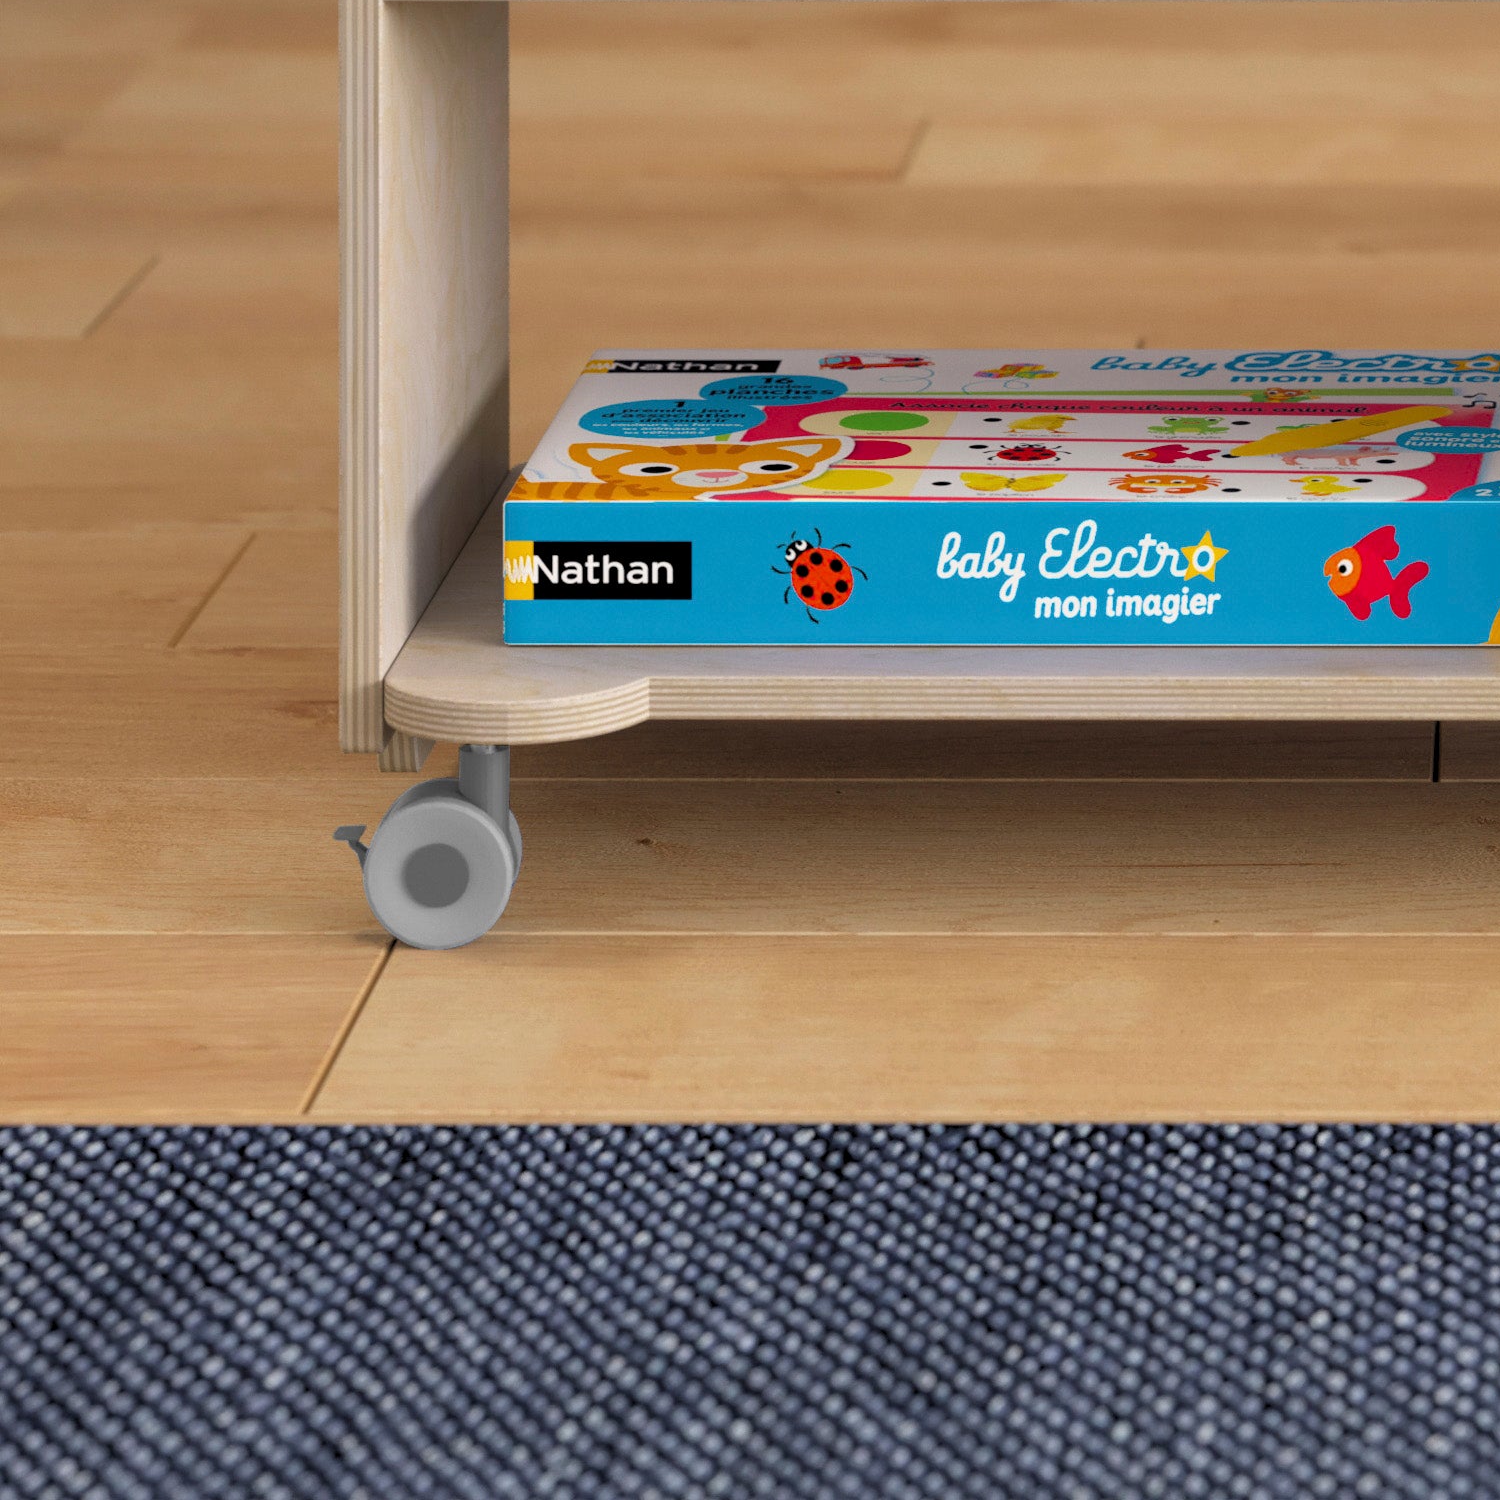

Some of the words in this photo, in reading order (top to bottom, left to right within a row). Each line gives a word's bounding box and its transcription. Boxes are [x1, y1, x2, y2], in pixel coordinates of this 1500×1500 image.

[611, 361, 759, 371] Nathan
[1090, 355, 1219, 377] baby
[1228, 351, 1500, 374] Electro
[1230, 374, 1322, 383] mon
[1000, 402, 1091, 411] chaque
[1100, 403, 1201, 412] couleur
[1475, 488, 1494, 497] 2
[533, 554, 674, 584] Nathan
[936, 531, 1026, 603] baby
[1038, 519, 1215, 579] Electro
[1034, 595, 1098, 618] mon
[1105, 586, 1222, 624] imagier
